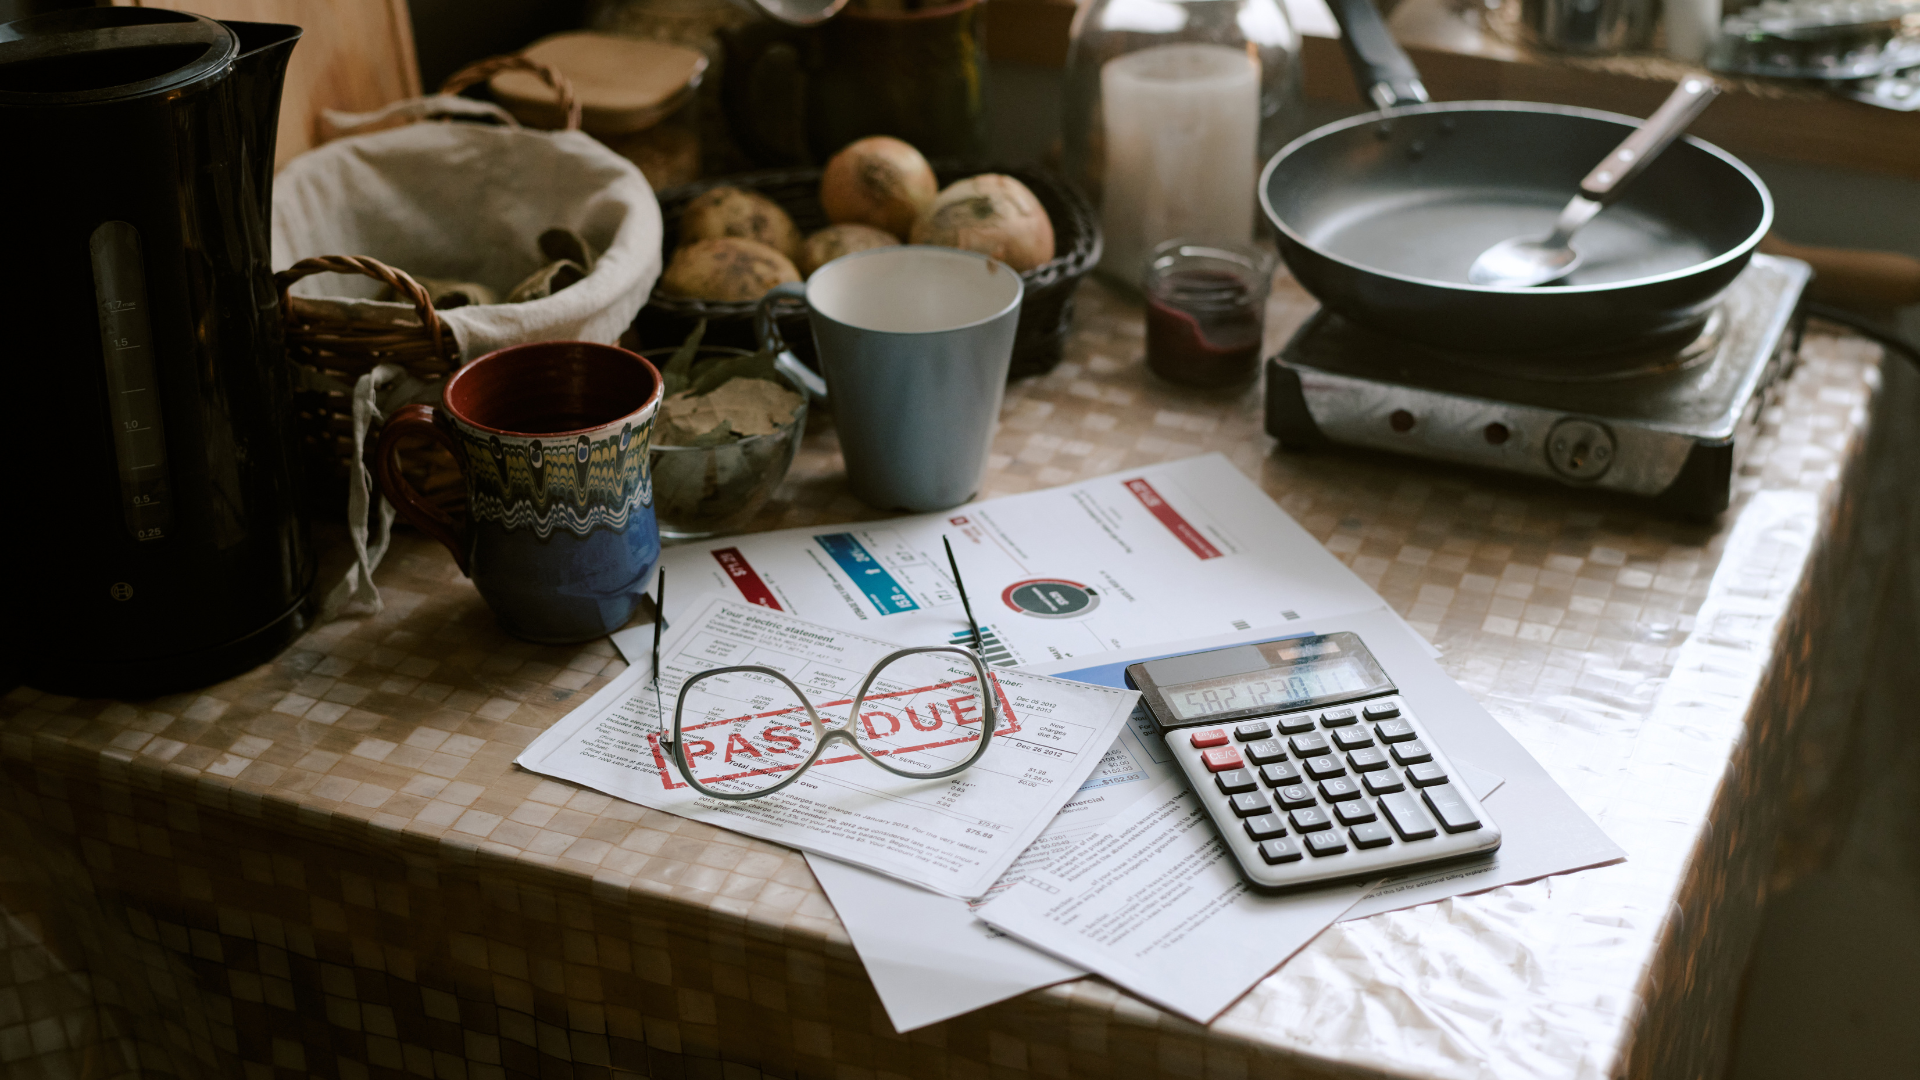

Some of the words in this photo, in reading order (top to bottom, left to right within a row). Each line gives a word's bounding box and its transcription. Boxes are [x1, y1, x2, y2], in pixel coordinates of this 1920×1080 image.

[114, 338, 128, 347] 1.5
[124, 420, 138, 429] 1.0
[133, 494, 150, 504] 0.5
[138, 528, 162, 538] 0.25
[718, 607, 744, 618] Your
[746, 616, 782, 629] electric
[785, 627, 834, 643] statement
[860, 702, 878, 710] 0.00
[1016, 695, 1030, 703] Dec
[1040, 701, 1057, 709] 2012
[1035, 706, 1052, 714] 2013
[1374, 704, 1394, 712] TAB
[682, 717, 832, 769] PAS
[859, 694, 984, 741] DUE
[769, 719, 787, 727] New
[787, 724, 811, 734] charges
[1039, 726, 1067, 736] charges
[1049, 722, 1065, 730] New
[1242, 723, 1264, 732] OFF
[788, 732, 813, 742] service
[1341, 730, 1365, 740] M+
[780, 749, 805, 759] charge
[1015, 742, 1031, 750] Dec
[1043, 749, 1063, 758] 2012
[1210, 749, 1238, 760] CE/C
[898, 756, 932, 770] SERVICE)
[1319, 758, 1332, 768] 9
[729, 760, 750, 770] Total
[750, 767, 782, 779] amount
[800, 781, 818, 790] owe
[1274, 765, 1288, 776] 8
[1229, 772, 1240, 782] 7
[1334, 780, 1346, 791] 6
[1289, 786, 1302, 797] 5
[1160, 800, 1176, 809] living
[1244, 795, 1256, 805] 4
[693, 801, 713, 811] billed
[719, 807, 744, 817] deposit
[785, 794, 813, 805] charges
[827, 806, 852, 815] change
[862, 815, 890, 825] January
[1160, 804, 1182, 820] address
[1348, 803, 1360, 814] 3
[728, 805, 760, 815] minimum
[775, 817, 806, 827] payment
[806, 825, 830, 834] charge
[1303, 810, 1318, 822] 2
[791, 808, 826, 820] December
[871, 829, 910, 842] considered
[1260, 818, 1270, 828] 1
[747, 804, 772, 812] charge
[889, 839, 924, 854] Beginning
[965, 828, 993, 839] $75.88
[1313, 832, 1337, 844] 00
[1274, 842, 1286, 852] 0
